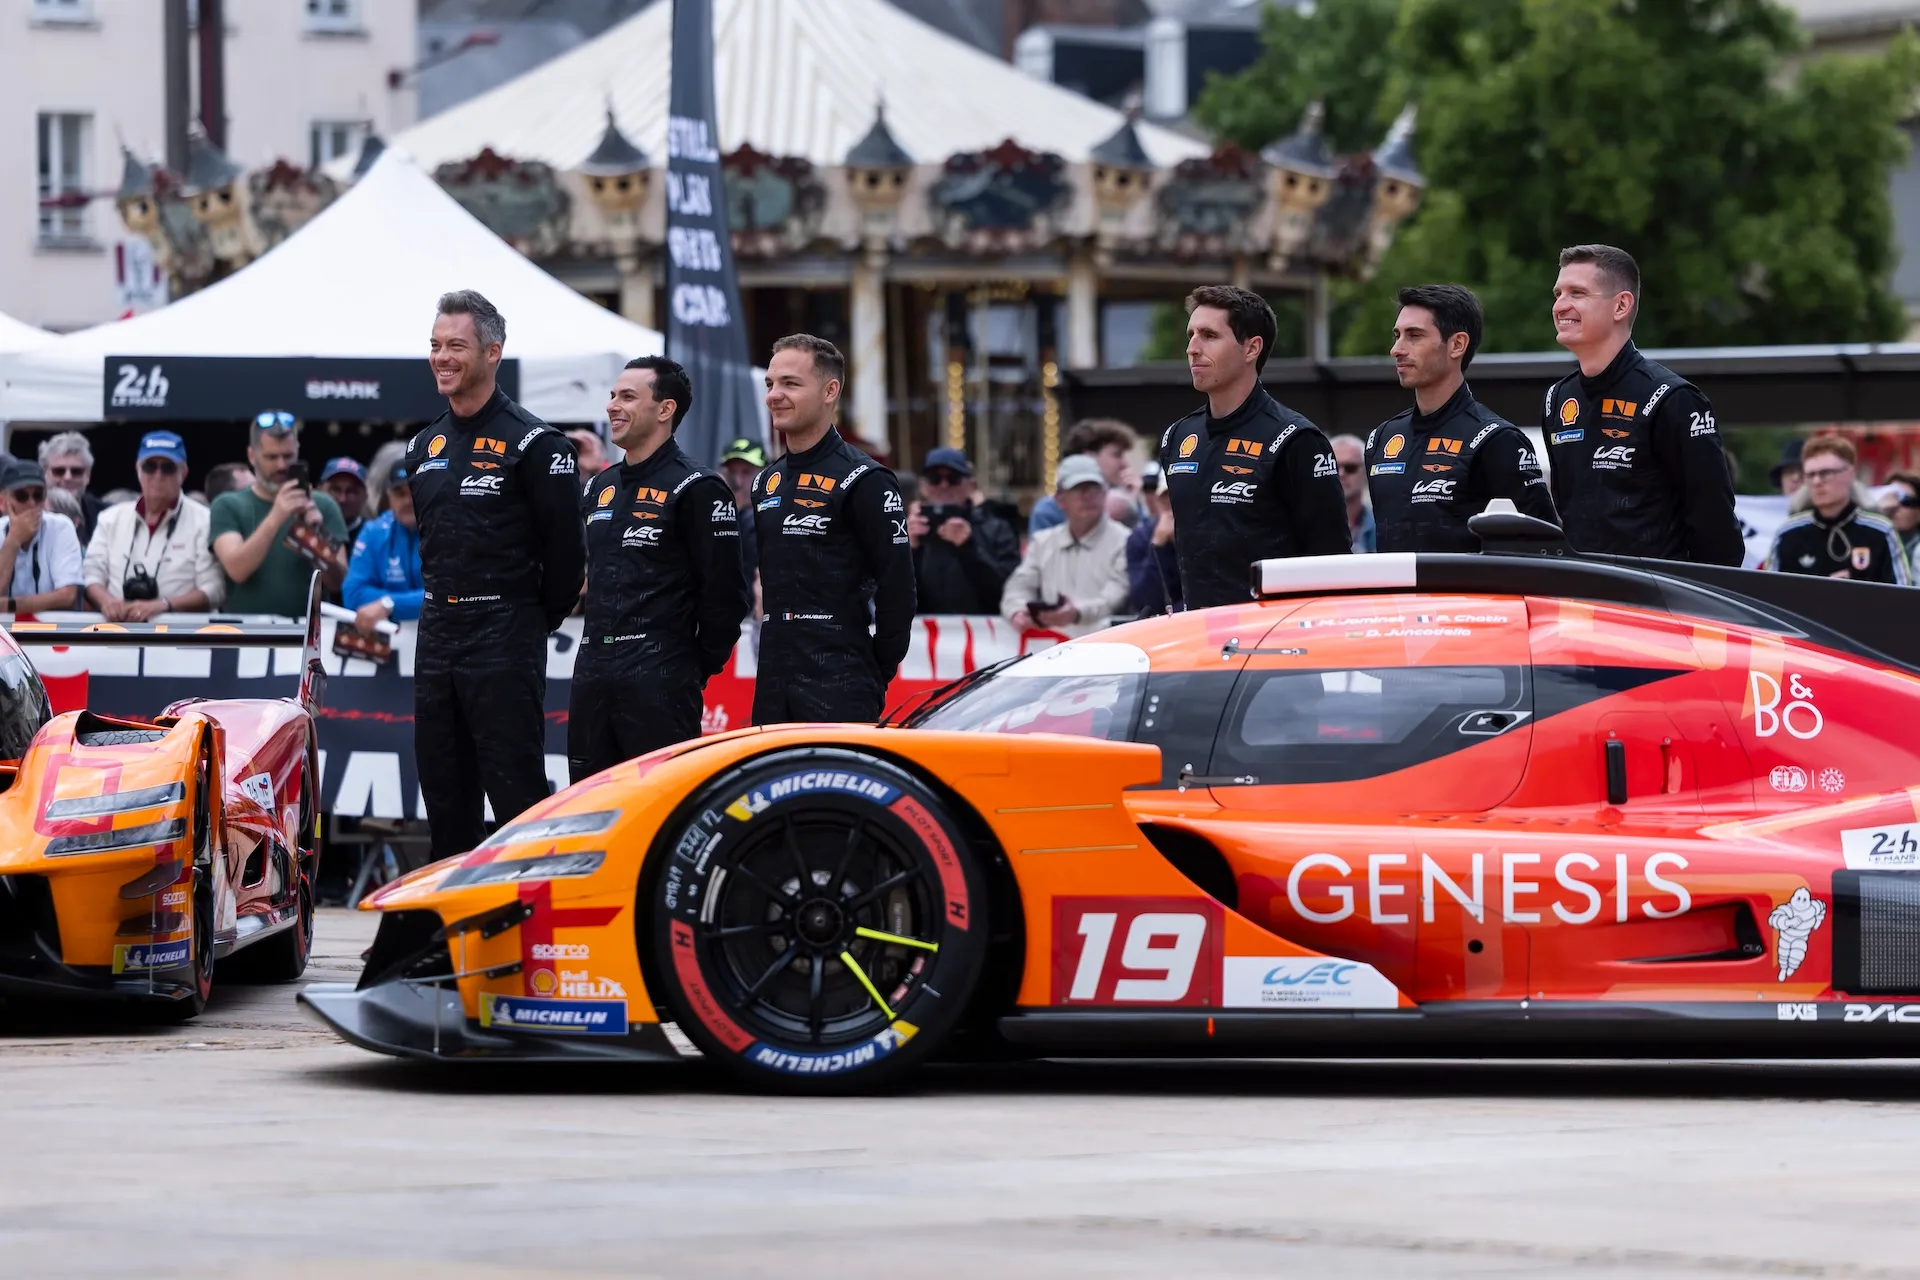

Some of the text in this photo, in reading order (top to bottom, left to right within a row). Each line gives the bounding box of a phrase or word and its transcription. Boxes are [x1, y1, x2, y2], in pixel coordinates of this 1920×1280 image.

[306, 381, 380, 399] SPARK
[1642, 384, 1670, 417] sparco
[518, 427, 545, 451] sparco
[1269, 424, 1298, 454] sparco
[1470, 422, 1499, 449] sparco
[1593, 446, 1636, 461] WEC
[461, 475, 504, 489] WEC
[673, 471, 702, 495] sparco
[840, 465, 869, 490] sparco
[1412, 479, 1457, 494] WEC
[1211, 480, 1258, 497] WEC
[783, 514, 832, 529] WEC
[622, 526, 663, 540] WEC
[459, 594, 501, 602] A.LOTTERER
[1365, 629, 1381, 637] D.
[770, 773, 889, 799] MICHELIN
[904, 805, 953, 867] PILOT SPORT
[1287, 852, 1692, 924] GENESIS
[162, 891, 186, 905] sparco
[949, 901, 965, 919] H
[675, 930, 692, 948] H
[145, 949, 187, 964] MICHELIN
[532, 944, 589, 960] sparco
[1069, 913, 1207, 1001] 19
[560, 970, 588, 981] Shell
[1263, 963, 1358, 985] WEC
[560, 977, 627, 997] HELIX
[515, 1008, 608, 1024] MICHELIN
[1777, 1003, 1817, 1020] HEXIS
[756, 1043, 875, 1072] MICHELIN
